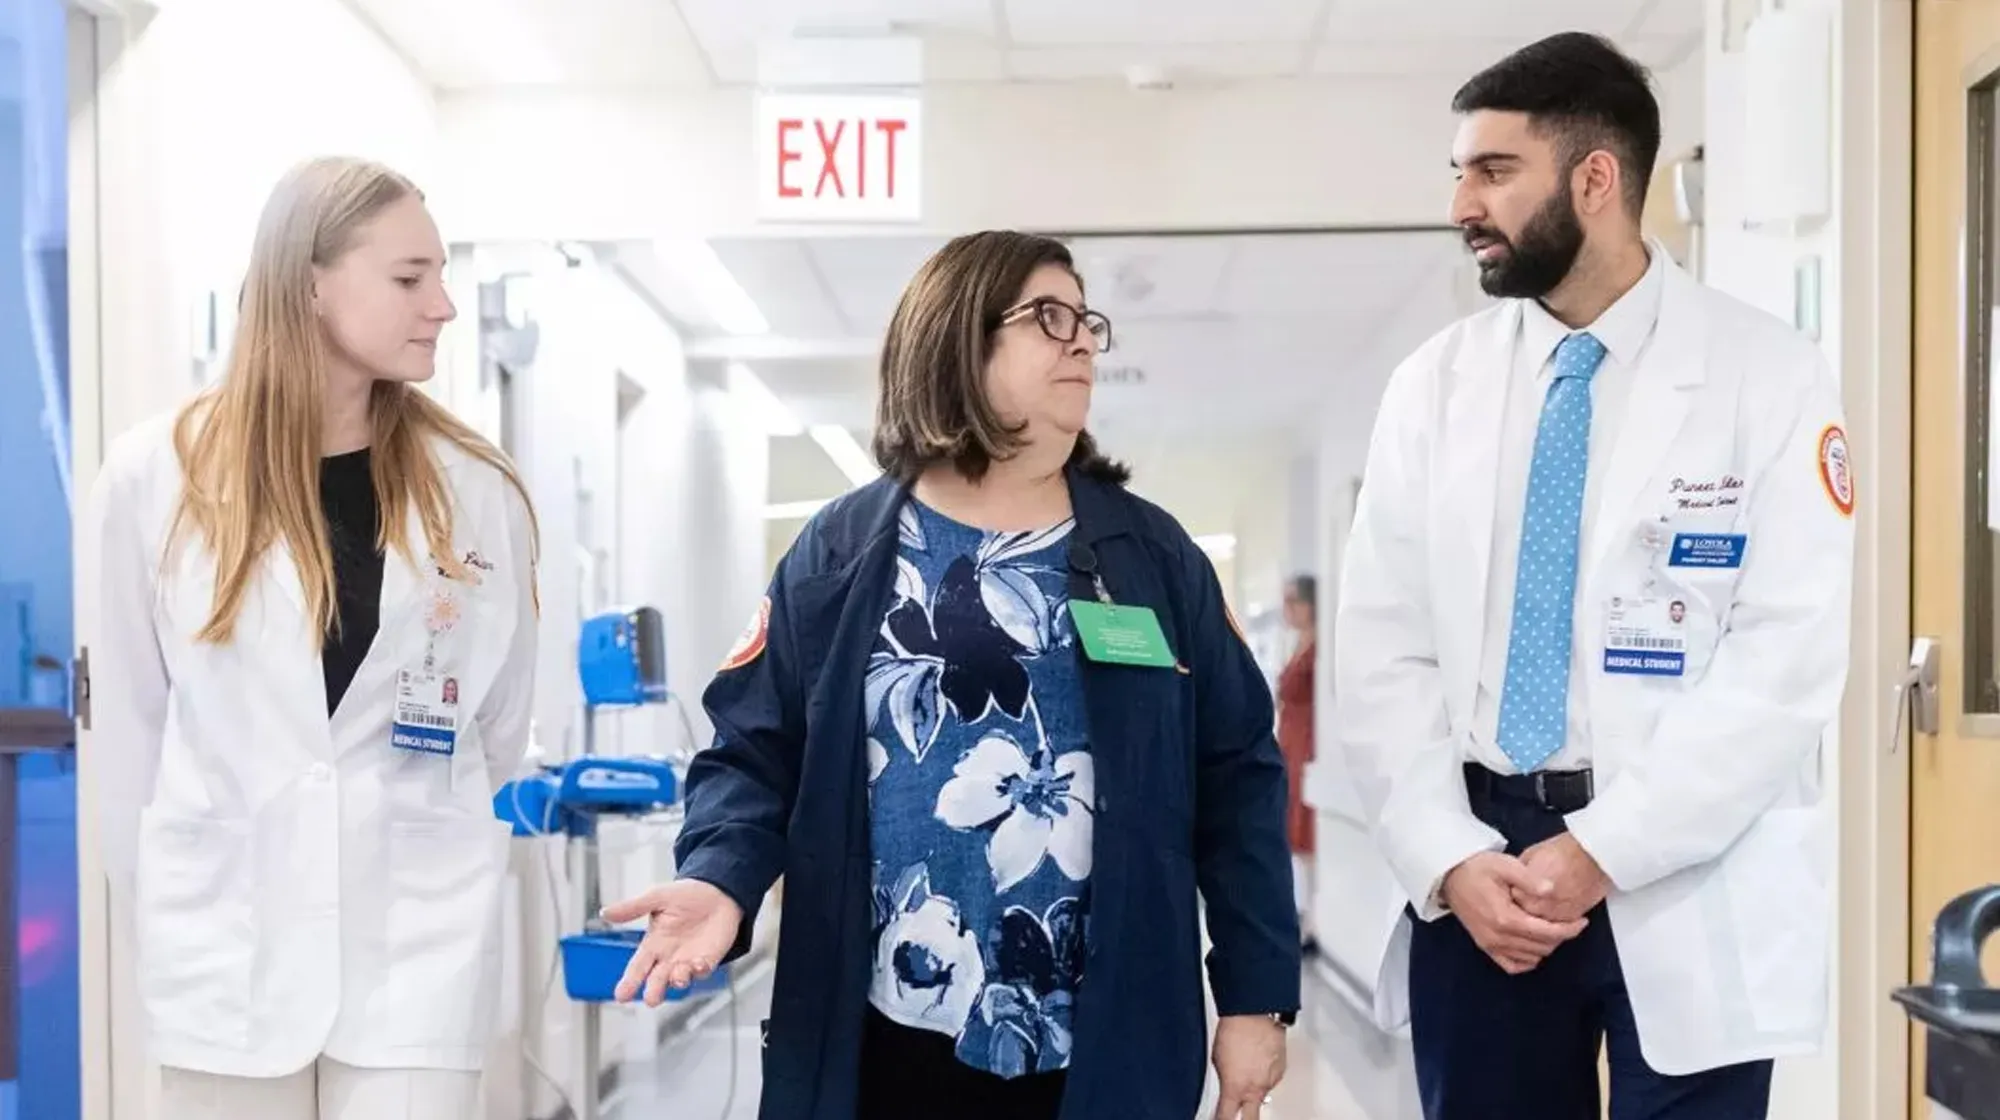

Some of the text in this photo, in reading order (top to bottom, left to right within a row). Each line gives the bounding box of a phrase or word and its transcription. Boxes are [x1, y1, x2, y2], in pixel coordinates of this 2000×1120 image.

[777, 119, 908, 198] EXIT
[1607, 656, 1682, 670] MEDICAL STUDENT
[393, 734, 452, 751] MEDICAL STUDENT
